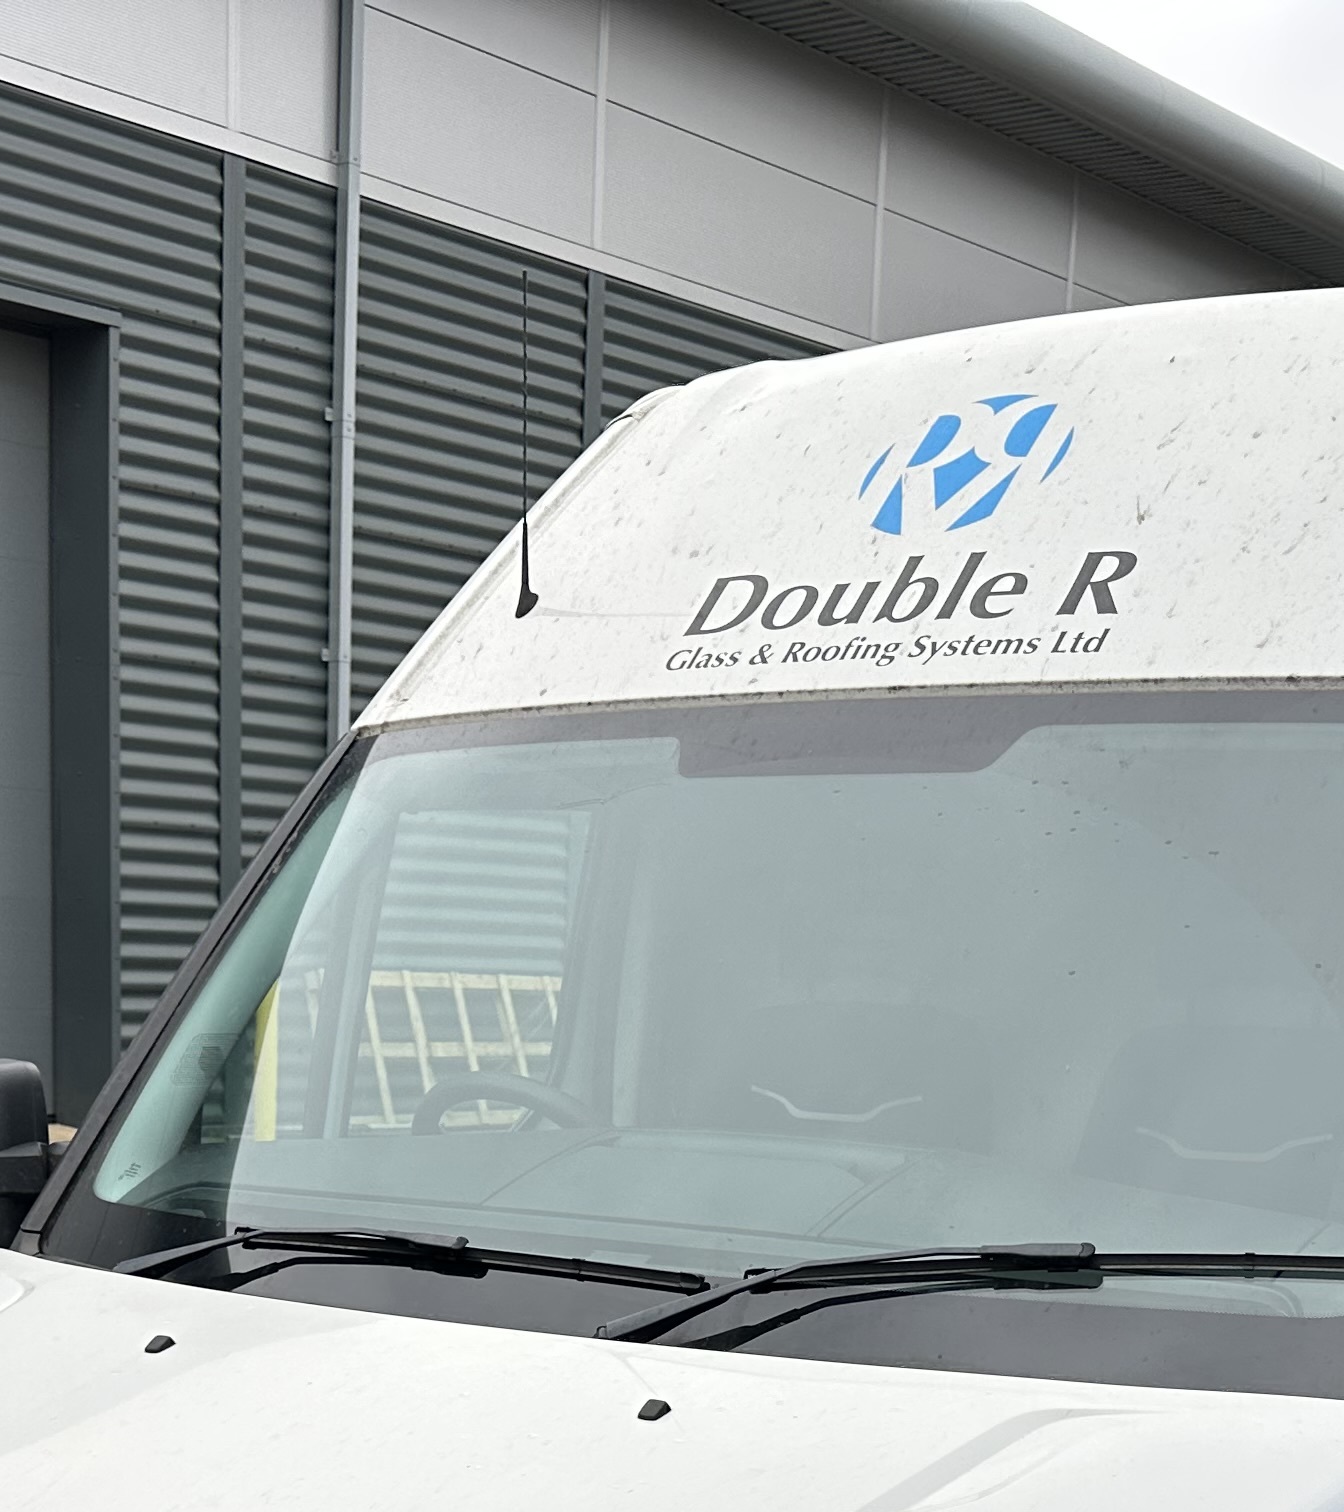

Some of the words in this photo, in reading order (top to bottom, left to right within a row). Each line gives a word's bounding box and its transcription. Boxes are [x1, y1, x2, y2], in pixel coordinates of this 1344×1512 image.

[682, 550, 1029, 637] Double
[1055, 550, 1138, 617] R
[665, 645, 742, 672] Glass
[749, 643, 774, 666] &
[781, 635, 904, 668] Roofing
[906, 632, 1040, 666] Systems
[1051, 627, 1111, 655] Ltd
